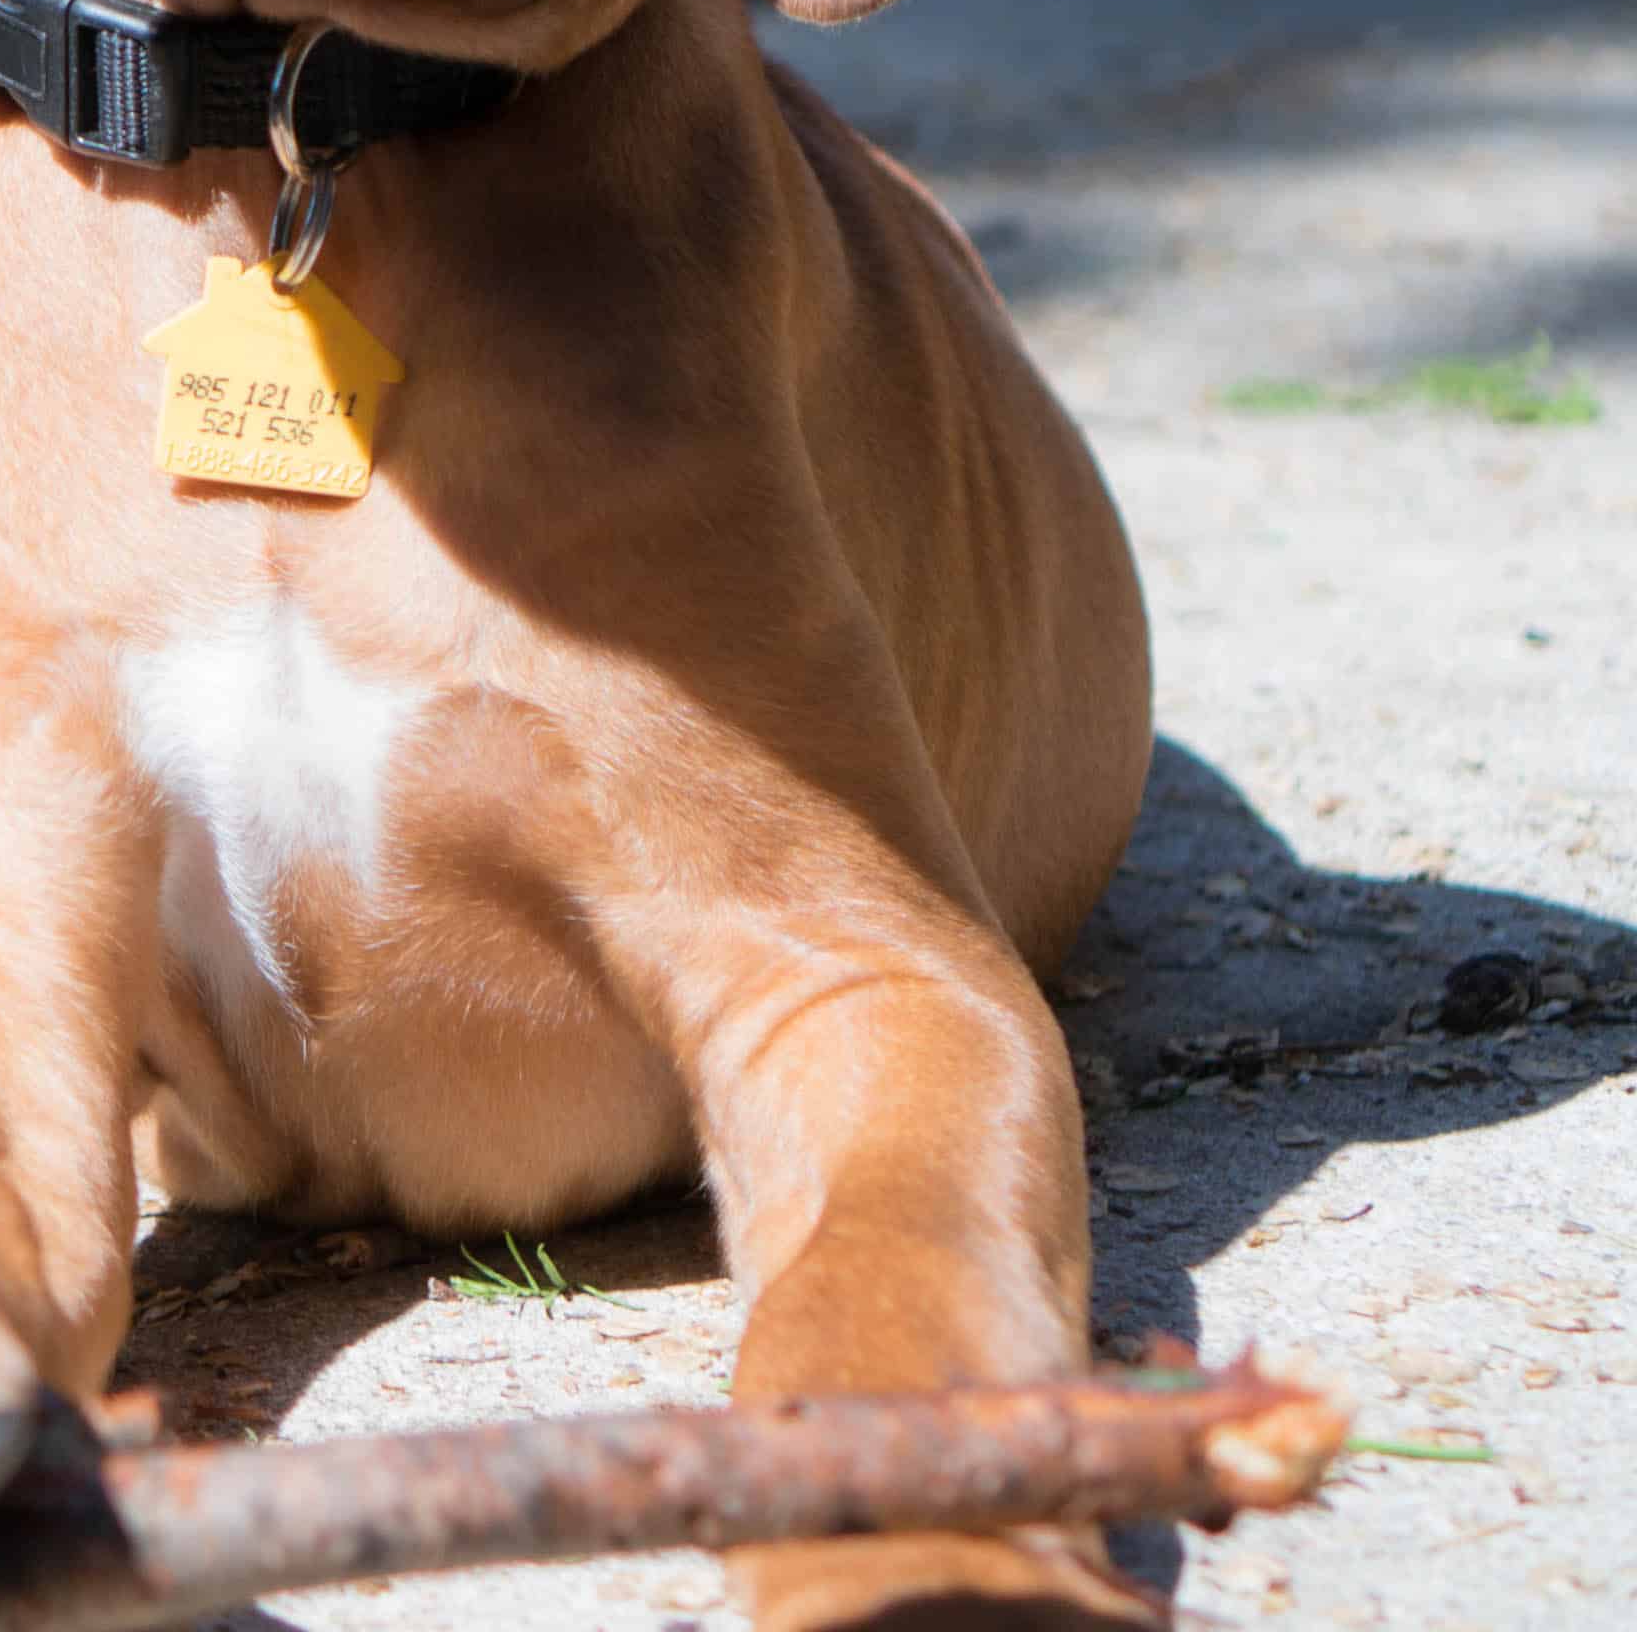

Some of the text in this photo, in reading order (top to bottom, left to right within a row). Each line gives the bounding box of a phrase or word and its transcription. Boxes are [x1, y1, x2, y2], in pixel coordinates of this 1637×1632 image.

[176, 373, 358, 417] 985 121 011
[198, 408, 318, 446] 521 536
